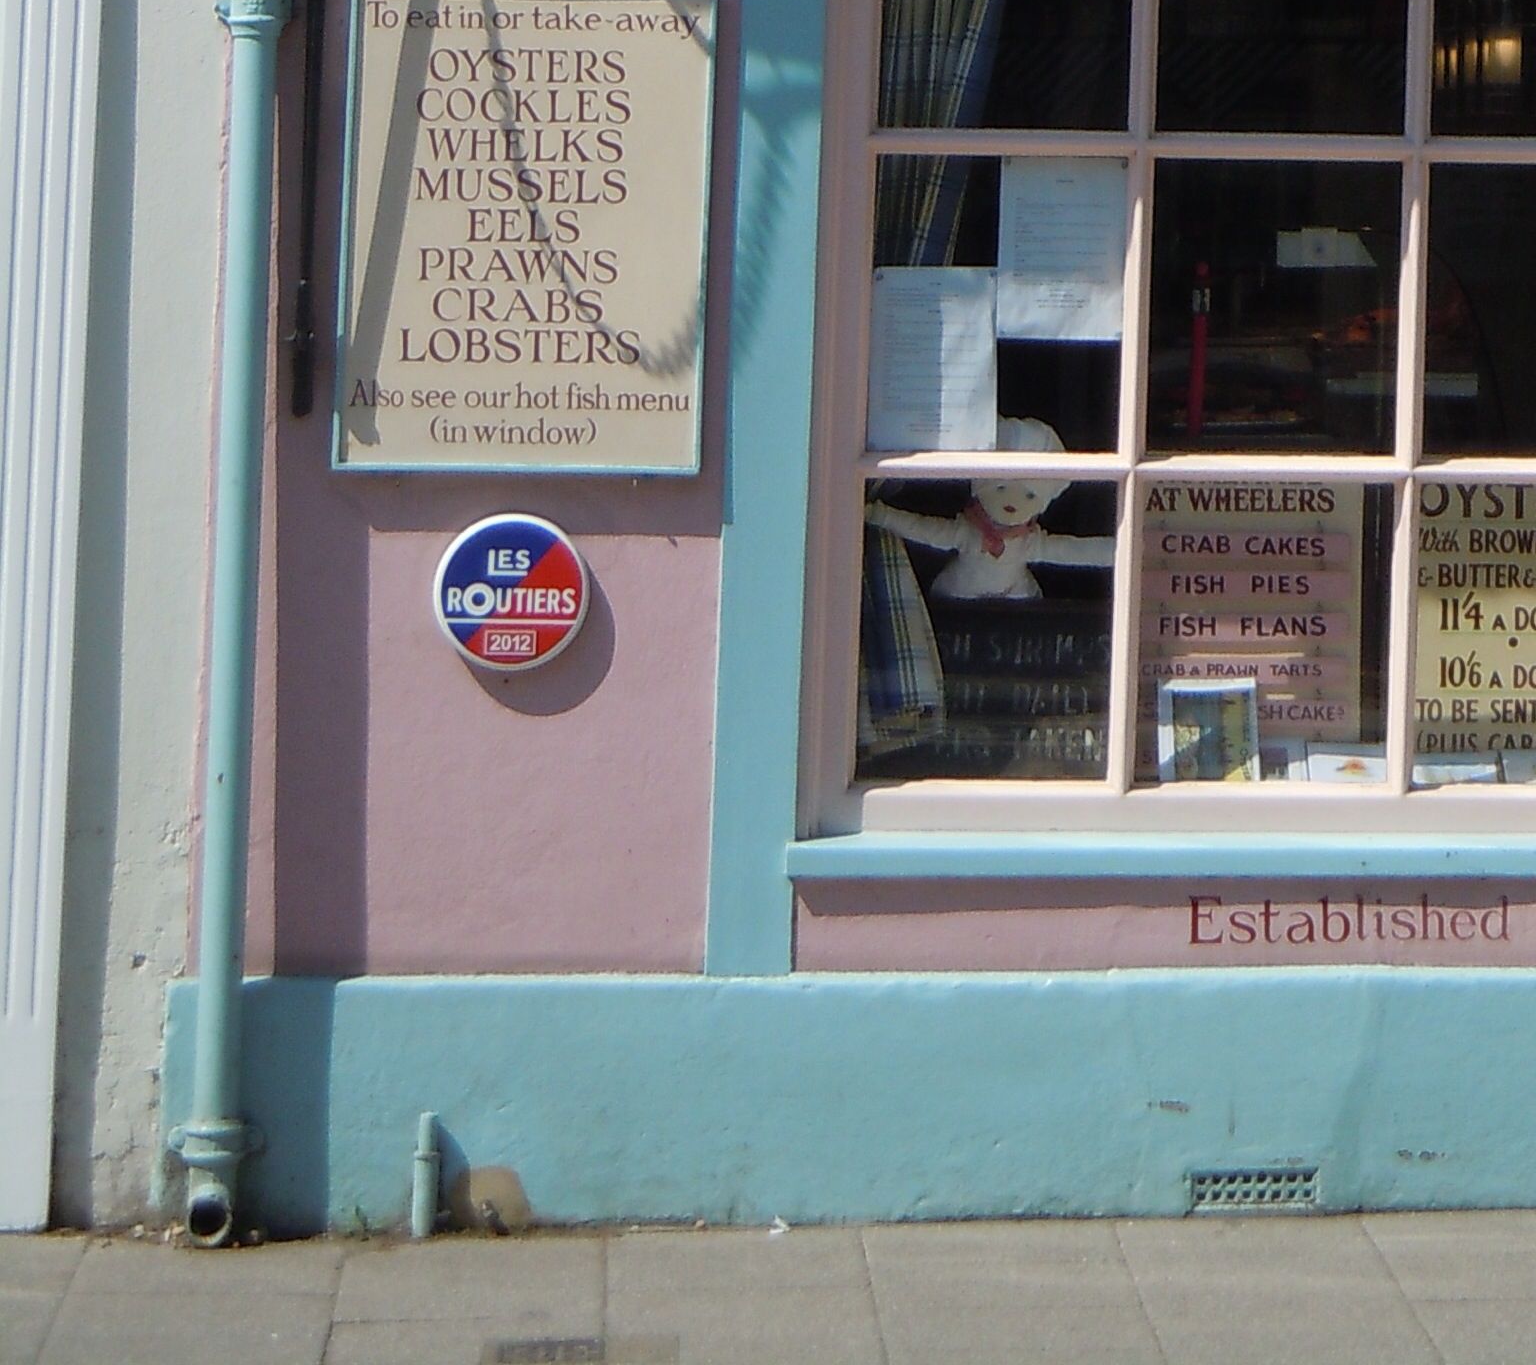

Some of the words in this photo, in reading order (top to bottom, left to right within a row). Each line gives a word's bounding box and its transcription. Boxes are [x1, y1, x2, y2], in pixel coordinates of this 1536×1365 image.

[367, 0, 399, 28] To
[407, 5, 452, 29] eat
[459, 5, 484, 29] in
[492, 10, 523, 29] or
[429, 48, 626, 84] OYSTERS
[416, 88, 631, 124] COCKLES
[427, 128, 623, 163] WHELKS
[415, 168, 628, 204] MUSSELS
[466, 208, 580, 243] EELS
[419, 247, 618, 284] PRAWNS
[432, 288, 603, 324] CRABS
[400, 328, 640, 365] LOBSTERS
[349, 379, 402, 407] Also
[411, 389, 456, 408] see
[464, 389, 511, 408] our
[515, 382, 559, 409] hot
[566, 382, 609, 410] fish
[617, 393, 690, 412] menu
[429, 417, 467, 444] (in
[474, 418, 598, 445] window)
[1146, 487, 1181, 511] AT
[1188, 488, 1335, 513] WHEELERS
[1161, 534, 1231, 554] CRAB
[1245, 536, 1326, 557] CAKES
[488, 548, 530, 576] LES
[1438, 564, 1520, 588] BUTTER
[447, 582, 577, 616] ROUTIERS
[1171, 575, 1225, 595] FISH
[1251, 575, 1310, 596] PIES
[1159, 616, 1217, 636] FISH
[1240, 616, 1327, 637] FLANS
[1492, 614, 1506, 631] A
[489, 634, 531, 651] 2012
[1142, 664, 1185, 676] CRAB
[1206, 664, 1259, 676] PRAWN
[1270, 664, 1322, 677] TARTS
[1489, 671, 1503, 689] A
[1416, 699, 1443, 723] TO
[1452, 699, 1479, 723] BE
[1188, 893, 1510, 946] Established
